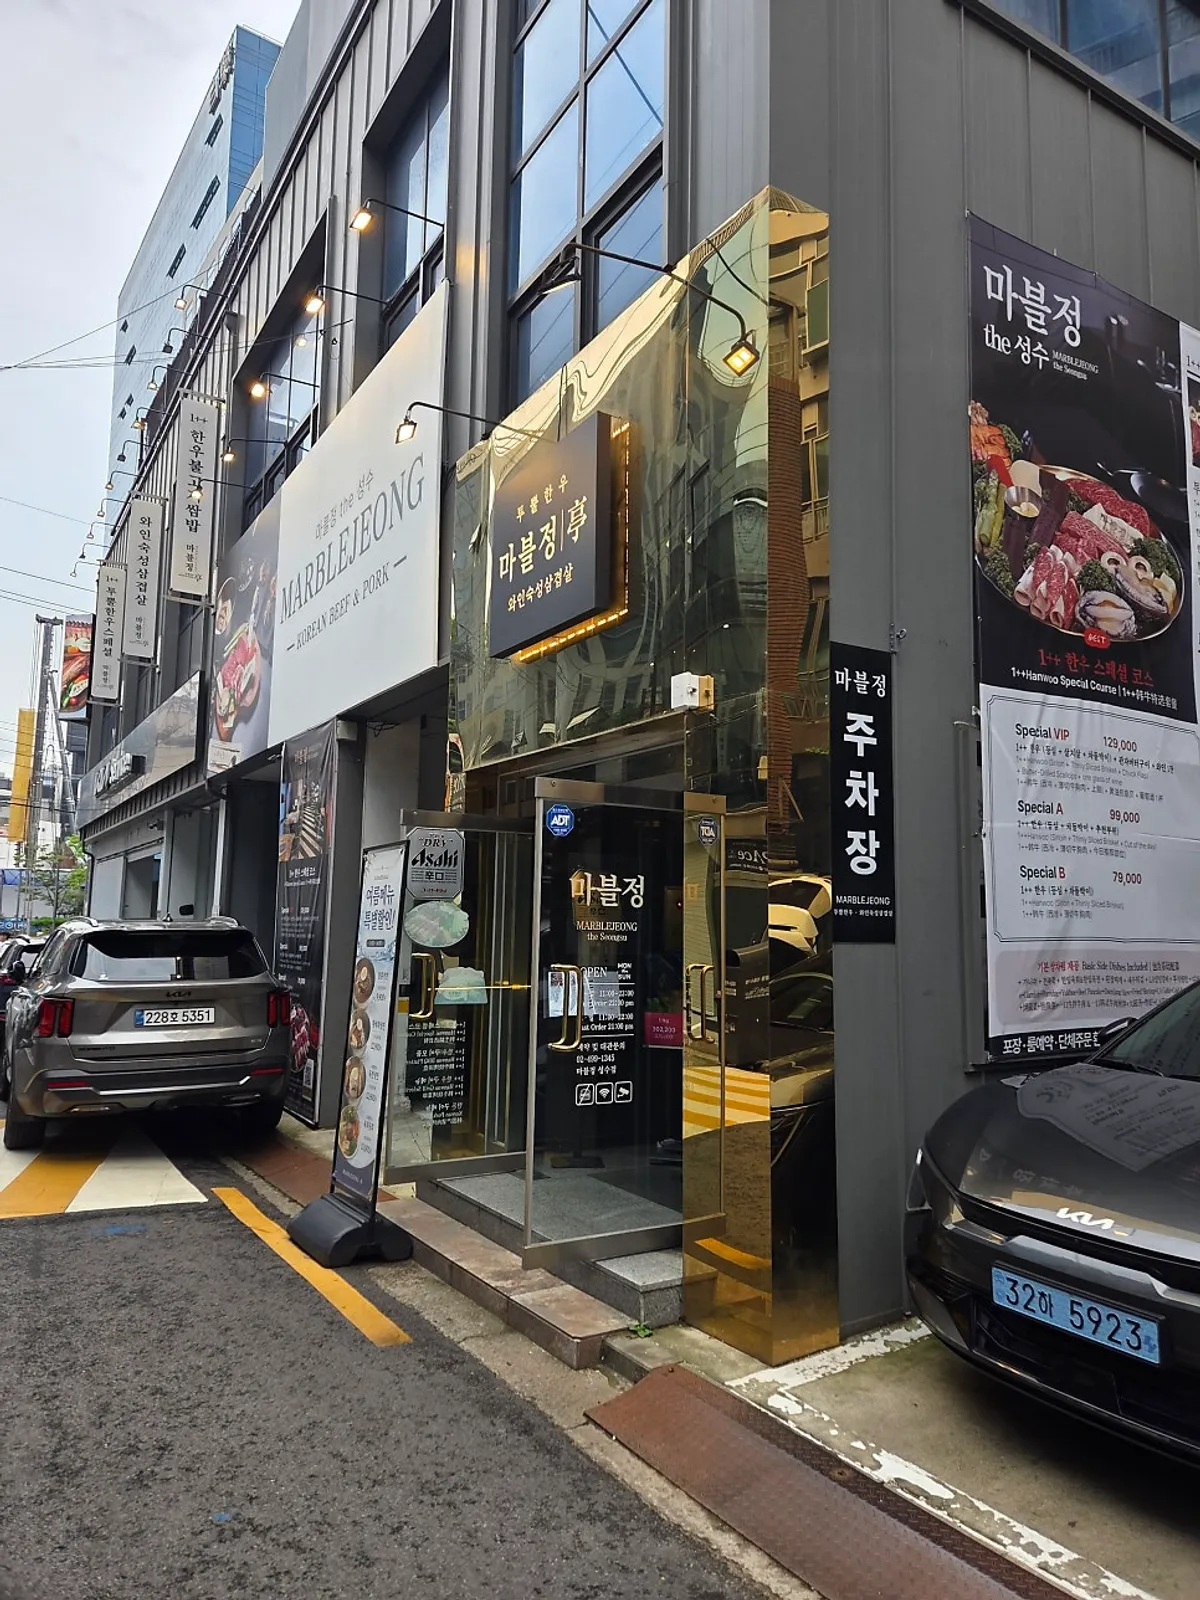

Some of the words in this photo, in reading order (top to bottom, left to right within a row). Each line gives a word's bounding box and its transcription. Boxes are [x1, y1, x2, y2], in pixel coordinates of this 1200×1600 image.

[983, 264, 1081, 347] 마블정
[983, 323, 1011, 355] the
[1014, 334, 1050, 370] 성수
[185, 429, 206, 533] 한우불고쌈밥
[280, 452, 425, 625] MARBLEJEONG
[499, 515, 557, 582] 마블정
[135, 516, 152, 606] 와인숙성삼겹살
[508, 562, 574, 612] 와인숙성삼겹살
[296, 610, 327, 650] KOREAN
[329, 593, 351, 627] BEEF
[362, 562, 390, 600] PORK
[1038, 649, 1061, 667] 1++
[1065, 652, 1091, 673] 한우
[1132, 668, 1155, 687] 코스
[834, 667, 886, 698] 마블정
[1060, 675, 1089, 691] Special
[1090, 681, 1117, 696] Course
[1015, 723, 1052, 739] Special
[1053, 728, 1070, 741] VIP
[1103, 736, 1138, 752] 129,000
[843, 712, 880, 876] 주차장
[1017, 800, 1054, 815] Special
[1056, 803, 1063, 815] A
[1109, 809, 1140, 824] 99,000
[551, 814, 570, 826] ADT
[411, 848, 458, 868] Asahi
[425, 871, 444, 881] 辛口
[1020, 865, 1057, 880] Special
[1058, 866, 1066, 879] B
[1112, 871, 1142, 886] 79,000
[569, 872, 645, 908] 마블정
[836, 895, 891, 905] MARBLEJEONG
[576, 920, 638, 932] MARBLEJEONG
[587, 932, 599, 941] the
[600, 932, 628, 942] Seongsu
[580, 966, 608, 978] OPEN
[145, 1011, 179, 1024] 228호
[182, 1009, 211, 1022] 5351
[1005, 1277, 1054, 1319] 32하
[1069, 1300, 1142, 1351] 5923
